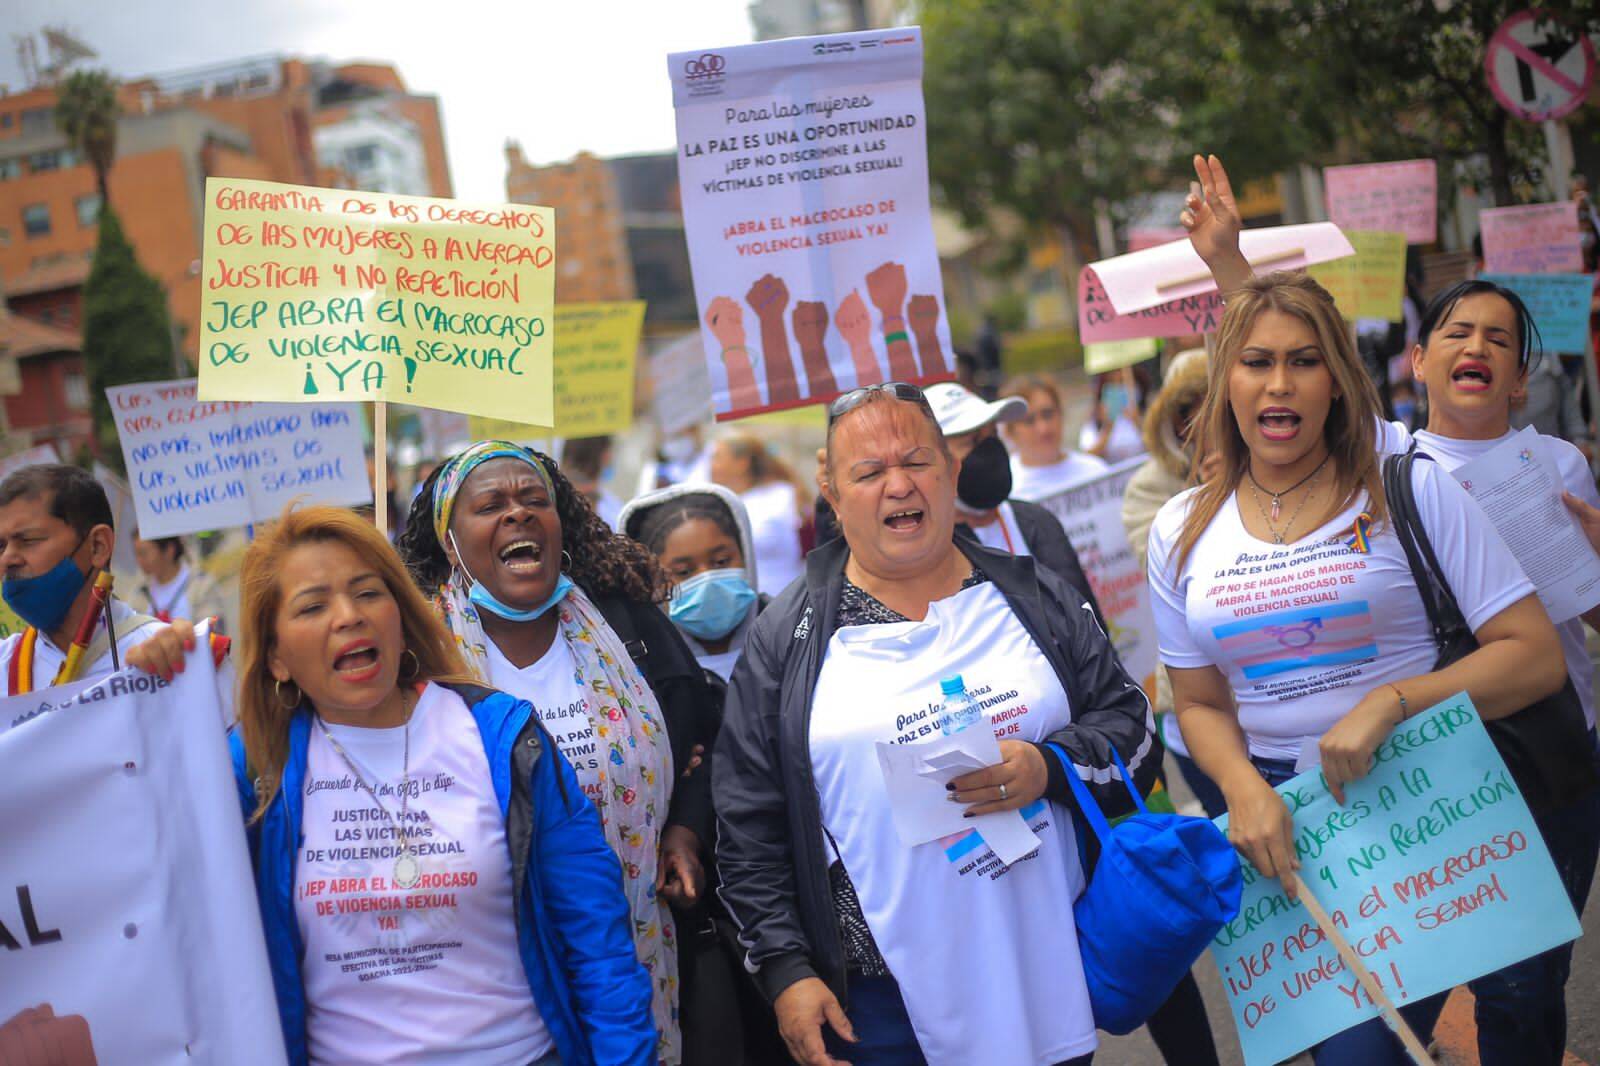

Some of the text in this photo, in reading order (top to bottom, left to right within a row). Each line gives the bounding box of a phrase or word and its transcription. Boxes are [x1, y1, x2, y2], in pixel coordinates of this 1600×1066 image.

[726, 96, 873, 124] Para las mujeres
[685, 114, 916, 157] LA PAZ ES UNA OPORTUNIDAD
[755, 154, 776, 167] NO
[780, 144, 848, 164] DISCRIMINE
[853, 144, 861, 153] A
[865, 139, 886, 152] LAS
[767, 173, 785, 186] DE
[788, 165, 851, 183] VIOLENCIA
[855, 156, 903, 173] SEXUAL!
[216, 187, 323, 212] GARANTIA
[341, 199, 377, 215] DE
[428, 204, 544, 238] DERECHOS
[771, 218, 786, 231] EL
[790, 202, 875, 228] MACROCASO
[878, 200, 896, 213] DE
[216, 223, 253, 246] DE
[303, 225, 414, 259] MUJERES
[421, 238, 438, 259] A
[737, 223, 889, 256] VIOLENCIA SEXUAL YA!
[209, 258, 320, 290] JUSTICIA
[356, 264, 386, 289] NO
[396, 267, 519, 303] REPETICIÓN
[207, 300, 268, 333] JEP
[278, 297, 365, 329] ABRA
[414, 302, 544, 346] MACROCASO
[209, 329, 523, 375] DE VIOLENCIA SEXUAL
[1214, 570, 1225, 578] LA
[1228, 568, 1247, 576] PAZ
[1249, 566, 1262, 574] ES
[1265, 562, 1287, 572] UNA
[1227, 584, 1241, 592] NO
[1243, 581, 1257, 590] SE
[1259, 574, 1294, 587] HAGAN
[1297, 568, 1315, 579] LOS
[1319, 561, 1367, 575] MARICAS
[1255, 591, 1267, 600] EL
[1270, 577, 1337, 598] MACROCASO
[1340, 575, 1356, 585] DE
[1233, 591, 1339, 617] VIOLENCIA SEXUAL!
[896, 708, 927, 731] Para
[1007, 723, 1020, 735] DE
[897, 731, 918, 745] PAZ
[918, 725, 932, 737] ES
[1378, 785, 1397, 811] A
[335, 828, 362, 841] LAS
[1347, 844, 1386, 877] NO
[1389, 770, 1515, 856] REPETICIÓN
[306, 841, 465, 862] DE VIOLENCIA SEXUAL
[1393, 831, 1527, 905] MACROCASO
[329, 877, 367, 894] ABRA
[371, 877, 386, 891] EL
[316, 901, 334, 916] DE
[406, 893, 457, 909] SEXUAL
[378, 915, 399, 931] YA!
[341, 960, 377, 973] EFECTIVA
[379, 958, 390, 967] DE
[344, 949, 388, 961] MUNICIPAL
[1244, 994, 1276, 1028] DE
